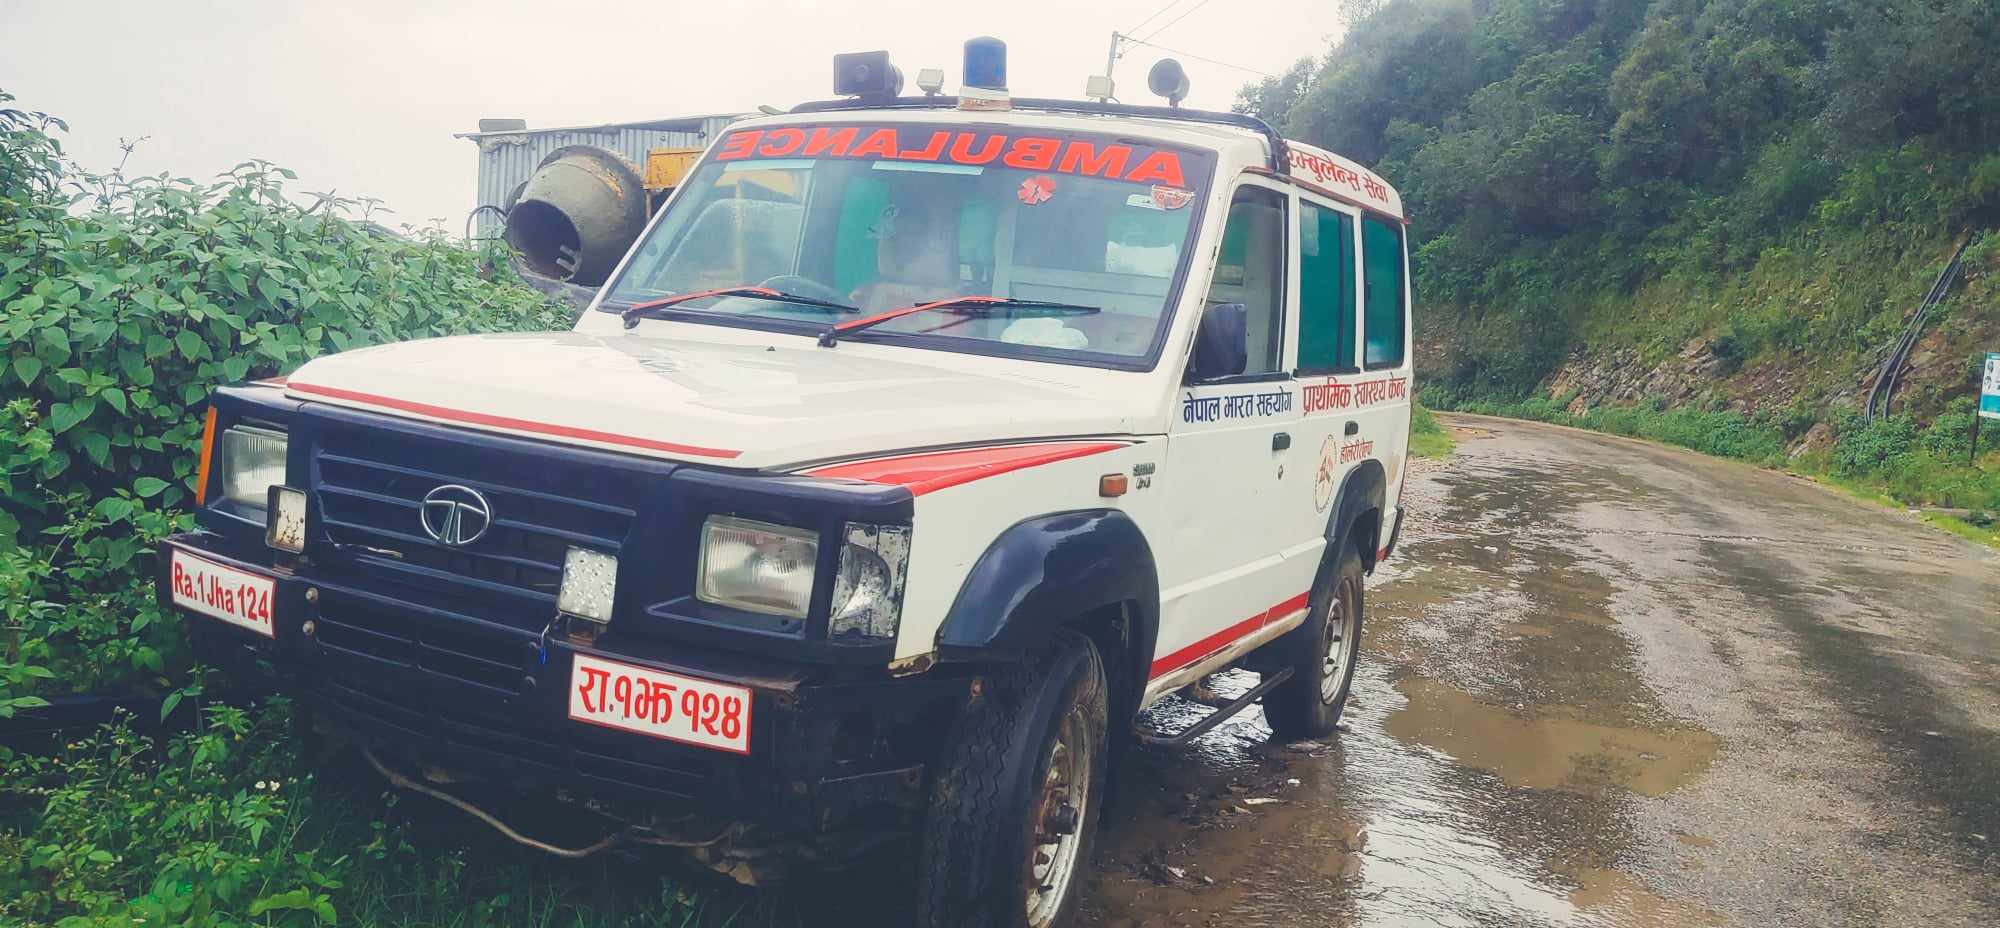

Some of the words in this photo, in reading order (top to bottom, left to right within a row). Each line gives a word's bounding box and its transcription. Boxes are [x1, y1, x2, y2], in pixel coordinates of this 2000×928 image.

[1363, 172, 1388, 203] सेवा
[1183, 392, 1221, 423] नेपाल
[1224, 394, 1254, 418] भारत
[1256, 385, 1293, 416] सहयोग
[1302, 376, 1352, 417] प्राथमिक
[237, 584, 269, 625] 124
[681, 689, 742, 739] १२४
